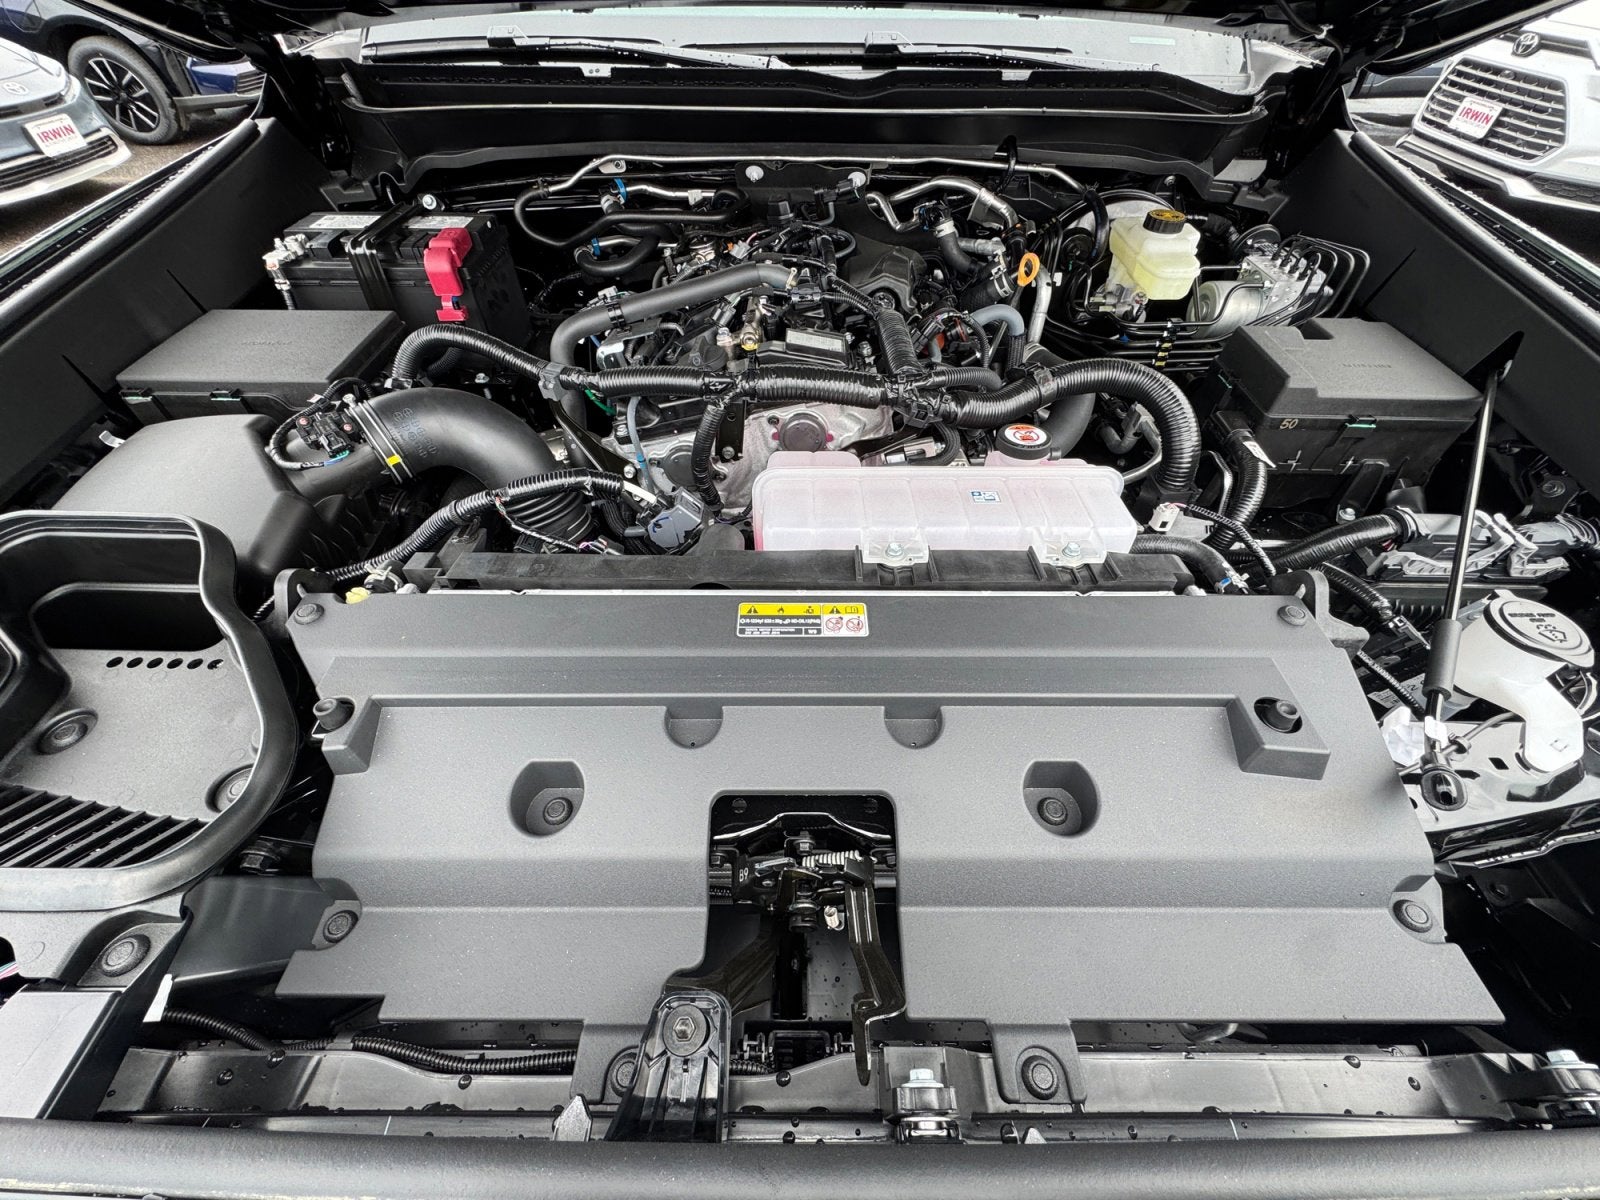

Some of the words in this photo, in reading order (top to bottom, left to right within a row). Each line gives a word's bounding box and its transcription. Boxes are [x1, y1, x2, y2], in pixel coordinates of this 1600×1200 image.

[1458, 106, 1494, 126] IRWIN
[36, 124, 76, 144] IRWIN
[1280, 418, 1299, 430] 50
[739, 867, 749, 882] B9
